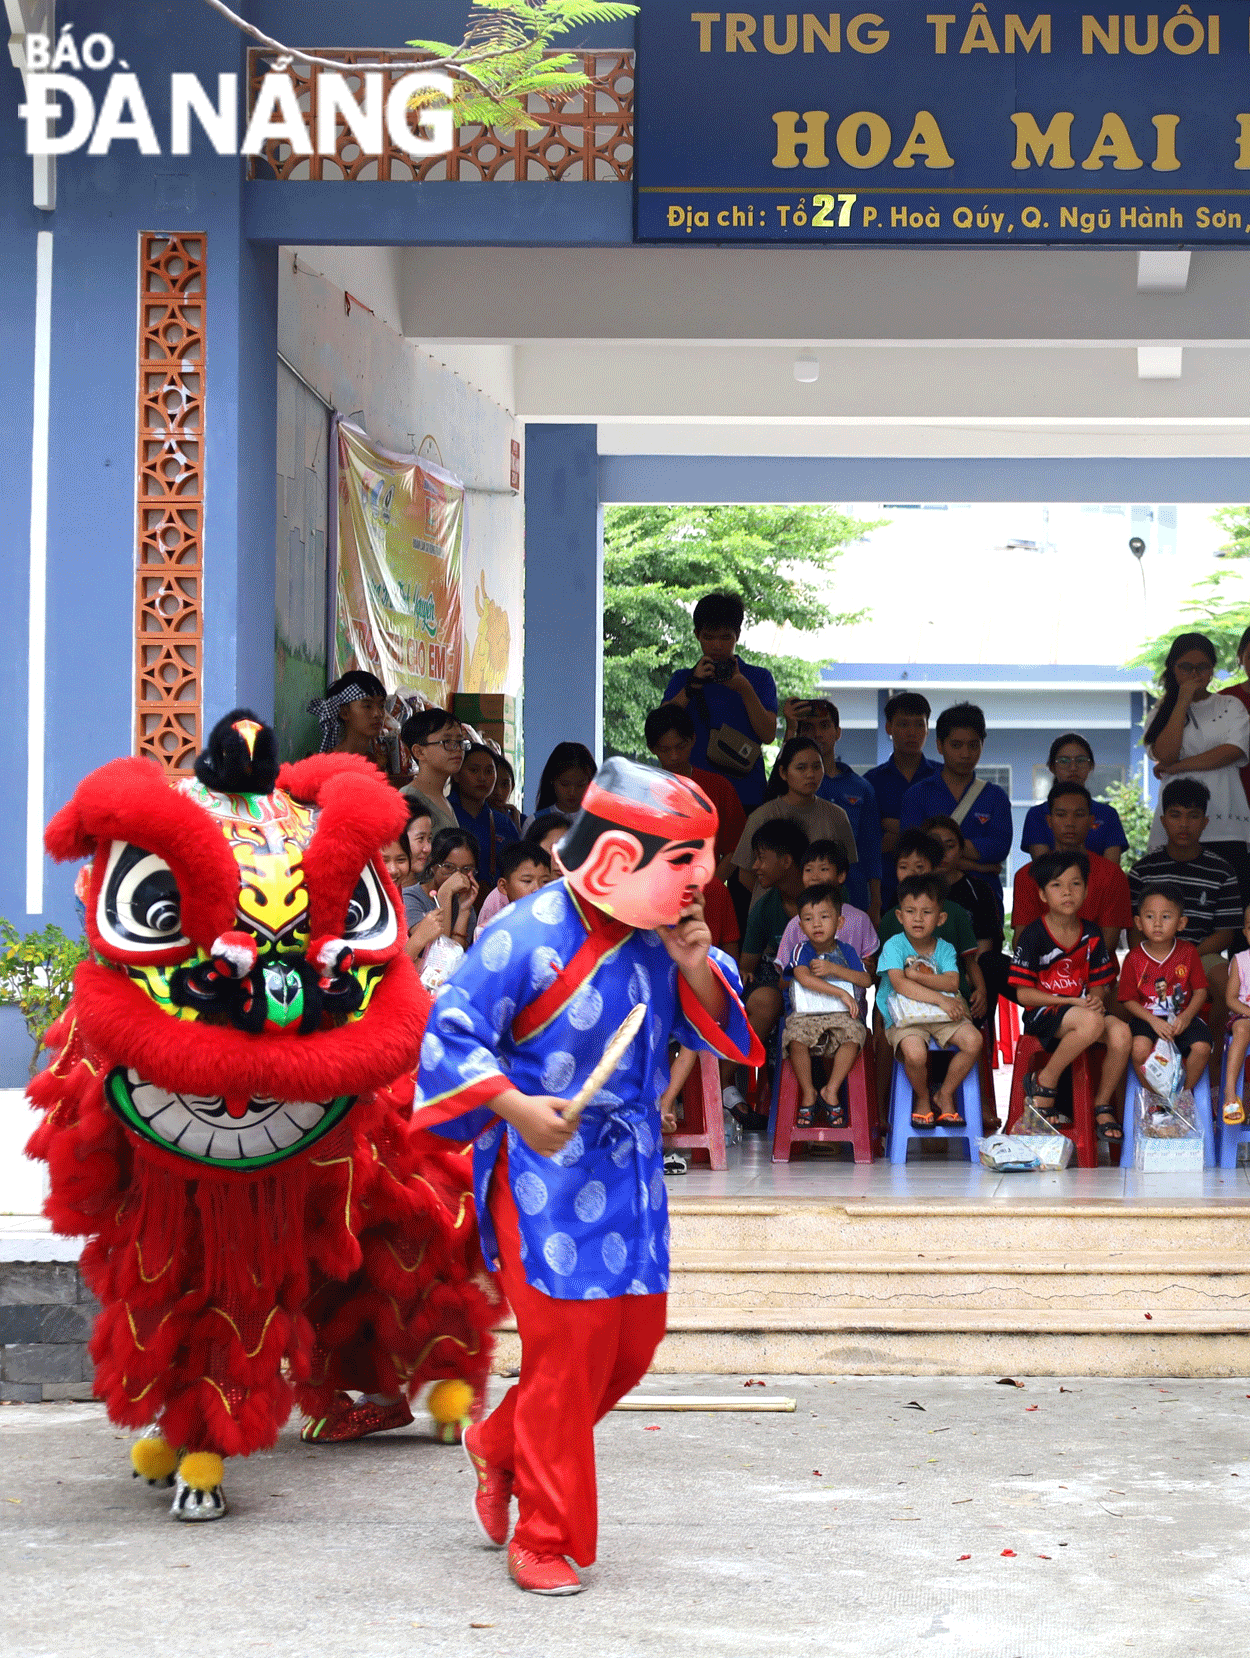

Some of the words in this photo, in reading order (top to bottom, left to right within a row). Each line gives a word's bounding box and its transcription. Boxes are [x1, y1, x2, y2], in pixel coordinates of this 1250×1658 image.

[691, 13, 890, 55] TRUNG
[926, 3, 1052, 55] TÂM
[1081, 4, 1220, 56] NUÔI
[771, 111, 956, 170] HOA
[1010, 112, 1182, 172] MAI
[667, 205, 710, 234] Địa
[776, 197, 809, 228] Tổ
[811, 193, 858, 228] 27
[862, 206, 884, 228] P.
[890, 206, 941, 229] Hoà
[1020, 206, 1050, 229] Q.
[1059, 206, 1112, 234] Ngũ
[1119, 206, 1184, 229] Hành
[429, 643, 447, 680] EM
